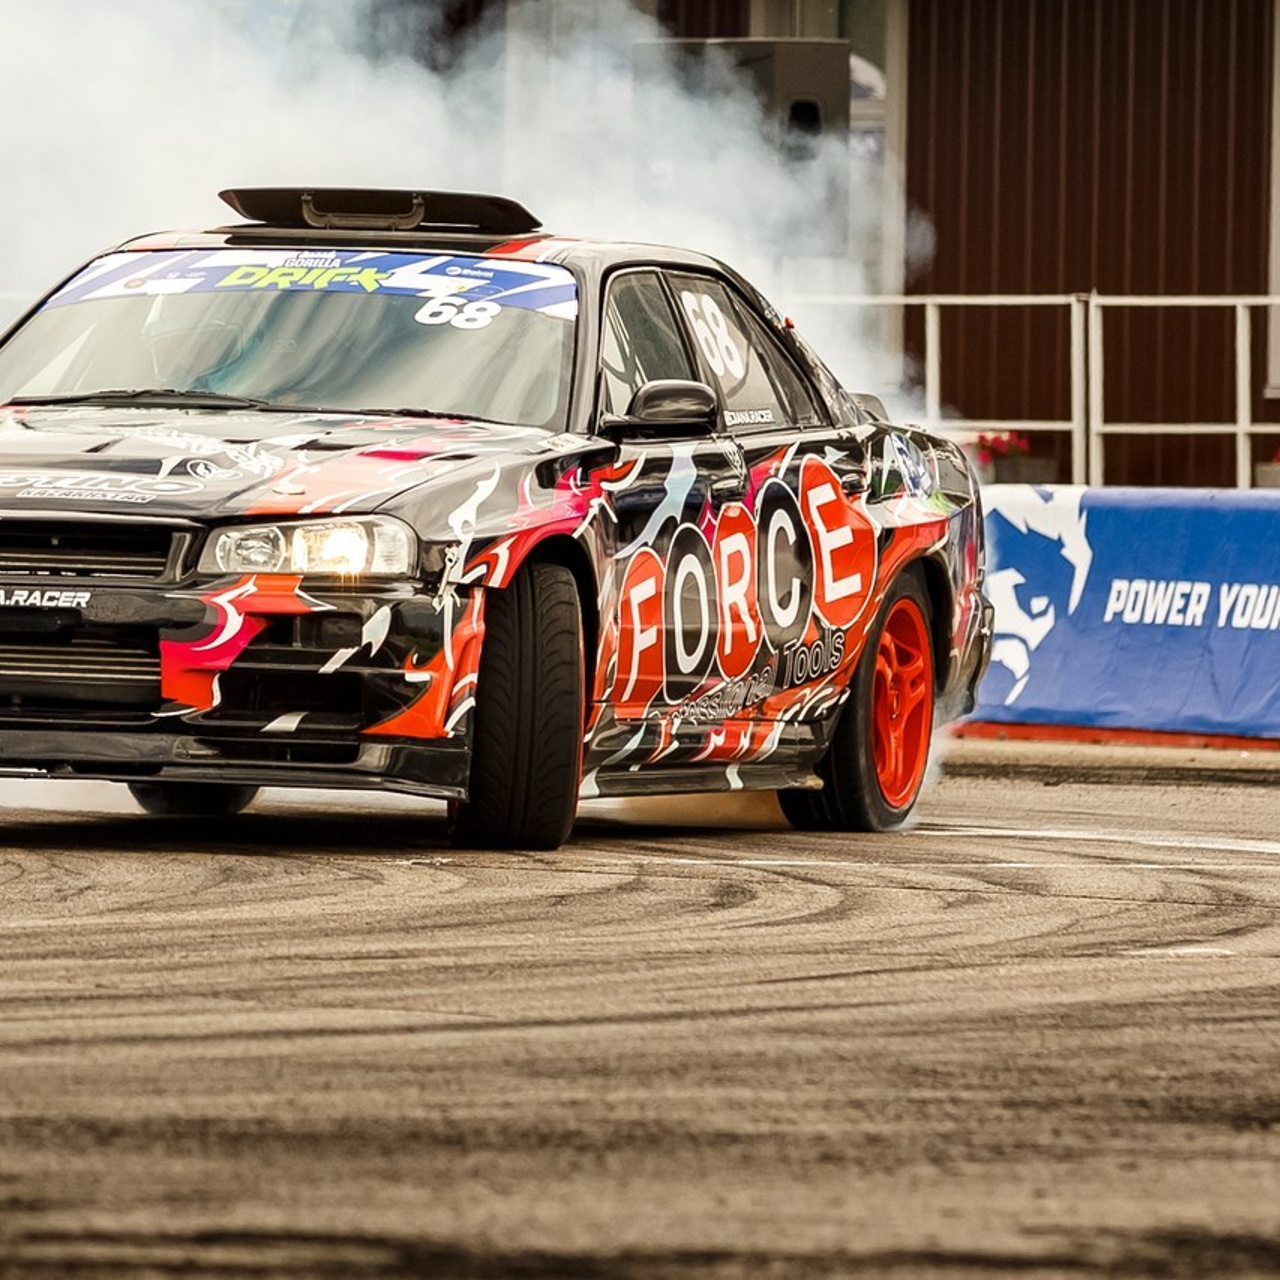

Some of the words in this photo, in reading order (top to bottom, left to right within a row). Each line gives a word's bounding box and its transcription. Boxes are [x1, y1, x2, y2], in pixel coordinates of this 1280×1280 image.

[214, 266, 396, 293] DRIFT
[285, 258, 342, 268] GORILLA
[414, 296, 501, 329] 68
[681, 290, 744, 380] 68
[620, 482, 862, 703] FORCE
[1103, 579, 1211, 627] POWER
[783, 628, 845, 689] Tools
